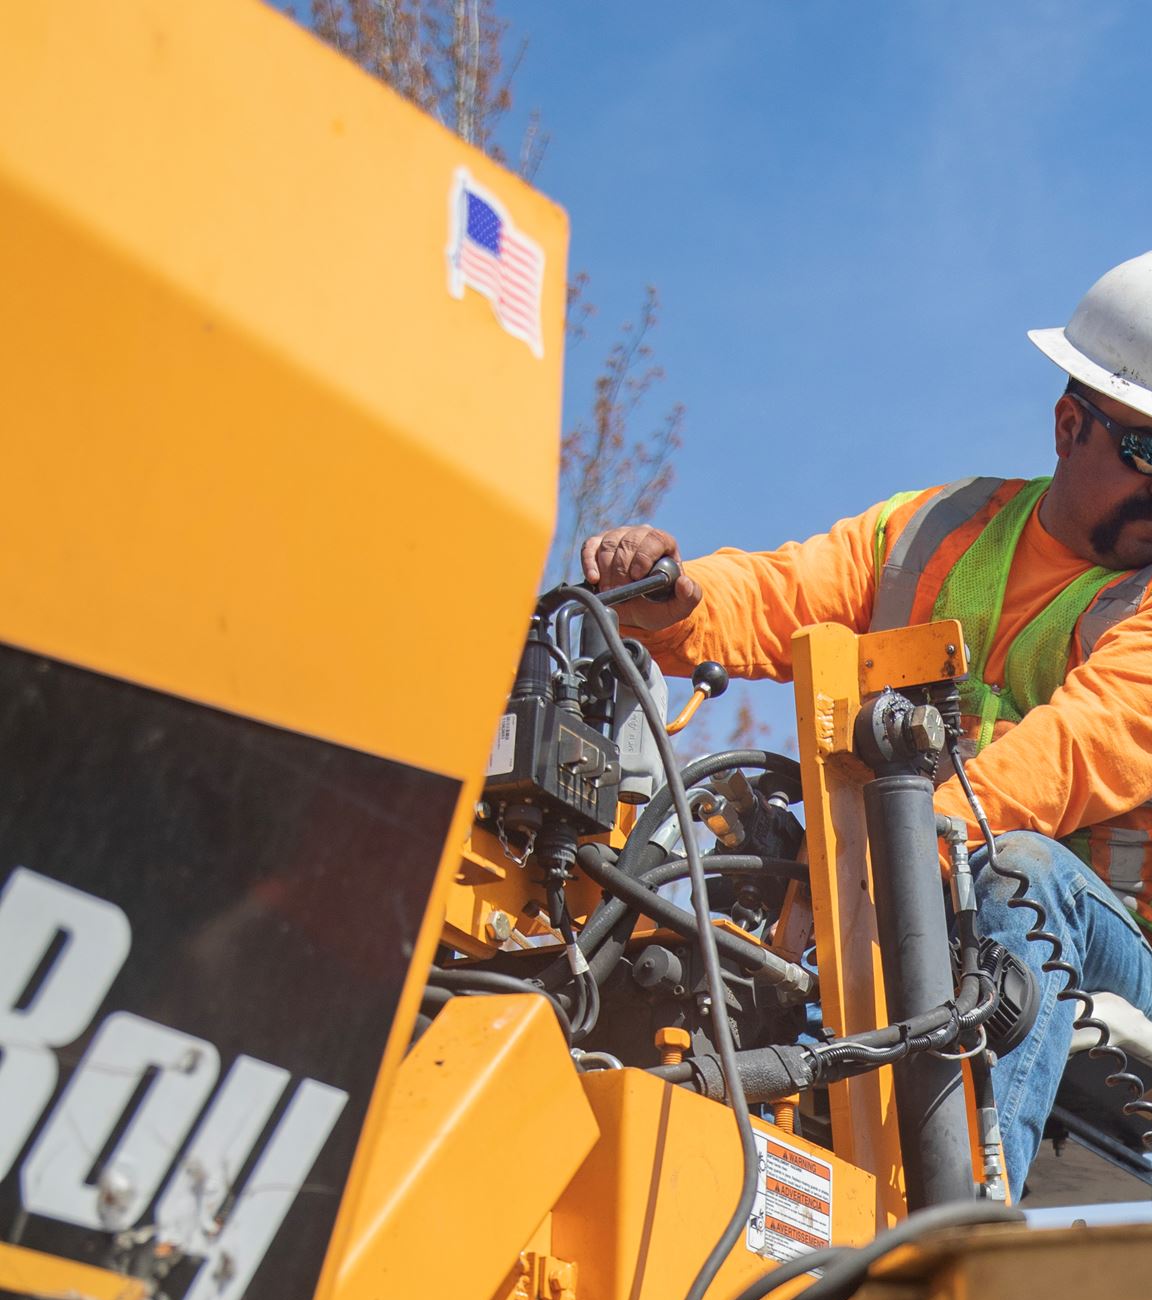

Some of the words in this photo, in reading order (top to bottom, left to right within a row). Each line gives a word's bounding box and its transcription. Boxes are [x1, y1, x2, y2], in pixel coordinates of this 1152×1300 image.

[789, 1152, 817, 1173] WARNING
[781, 1184, 822, 1211] ADVERTENCIA
[776, 1221, 825, 1249] AVERTISSEMENT
